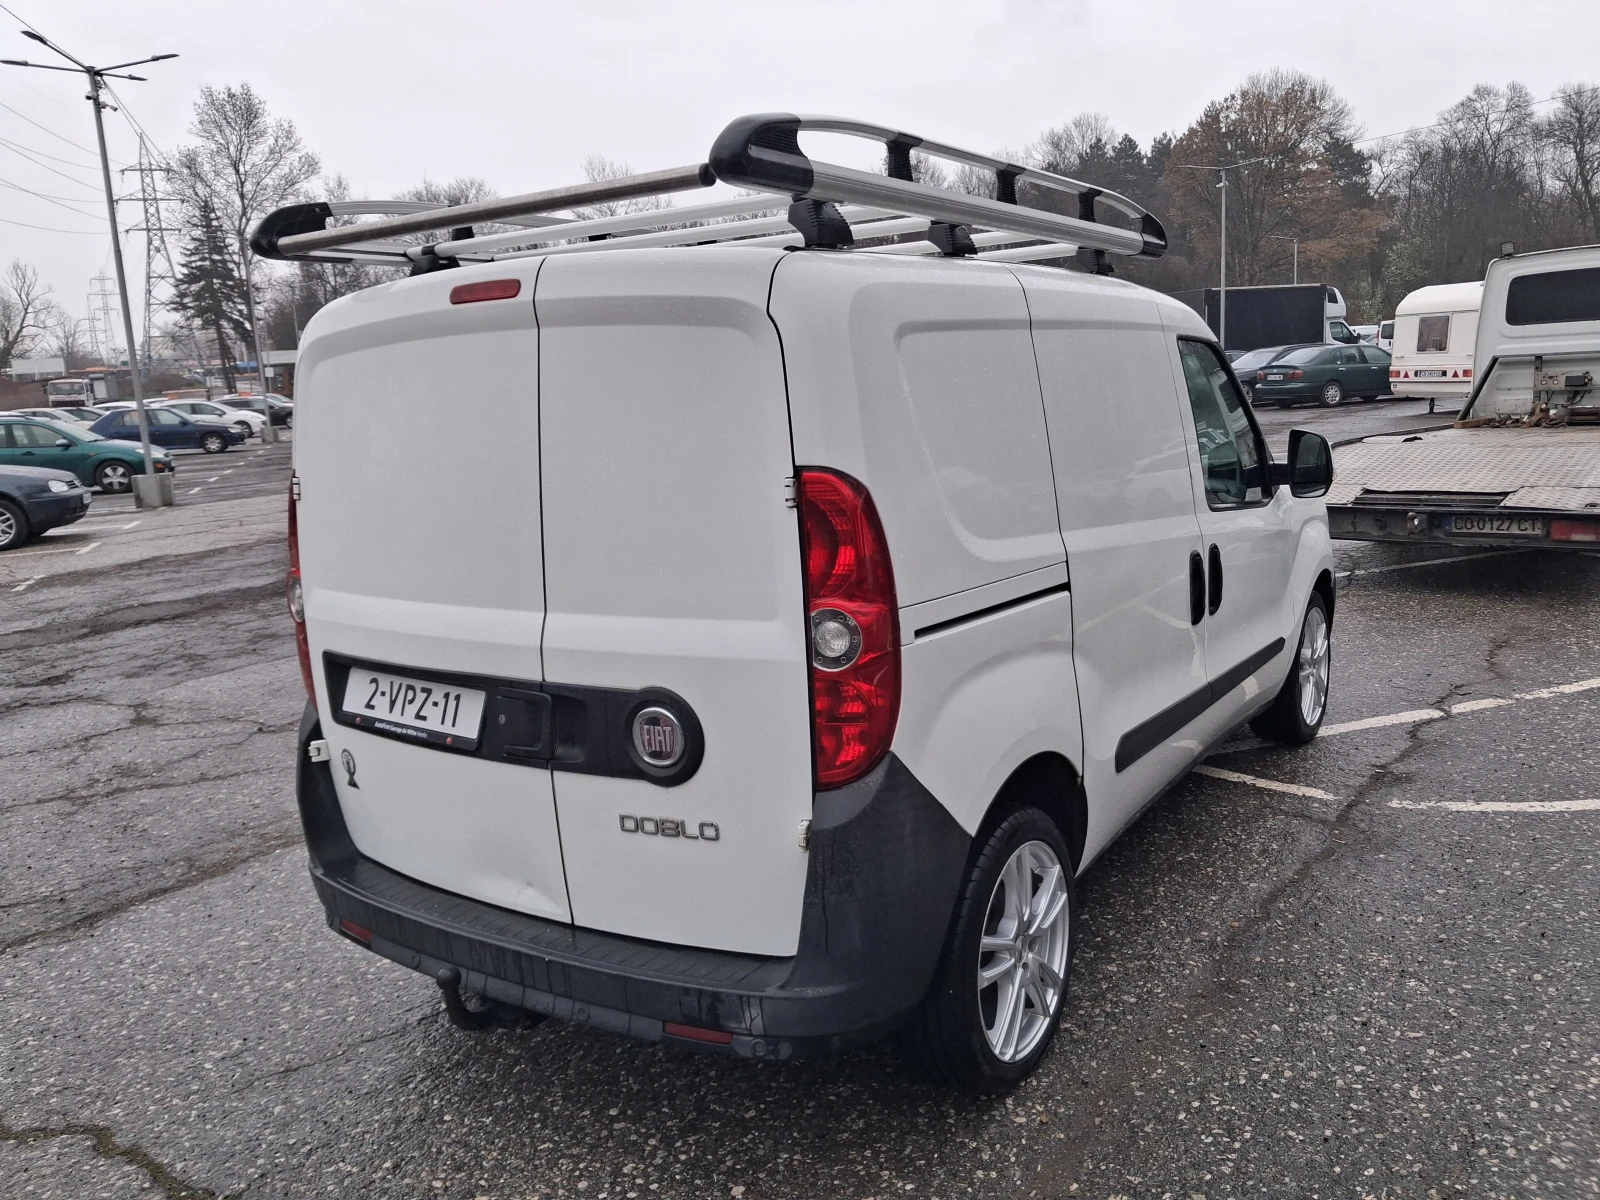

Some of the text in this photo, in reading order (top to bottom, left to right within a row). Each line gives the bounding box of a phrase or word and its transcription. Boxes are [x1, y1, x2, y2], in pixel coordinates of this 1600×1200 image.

[364, 677, 462, 728] 2-VPZ-11
[643, 724, 671, 752] FIAT
[619, 814, 720, 841] DOBLO
